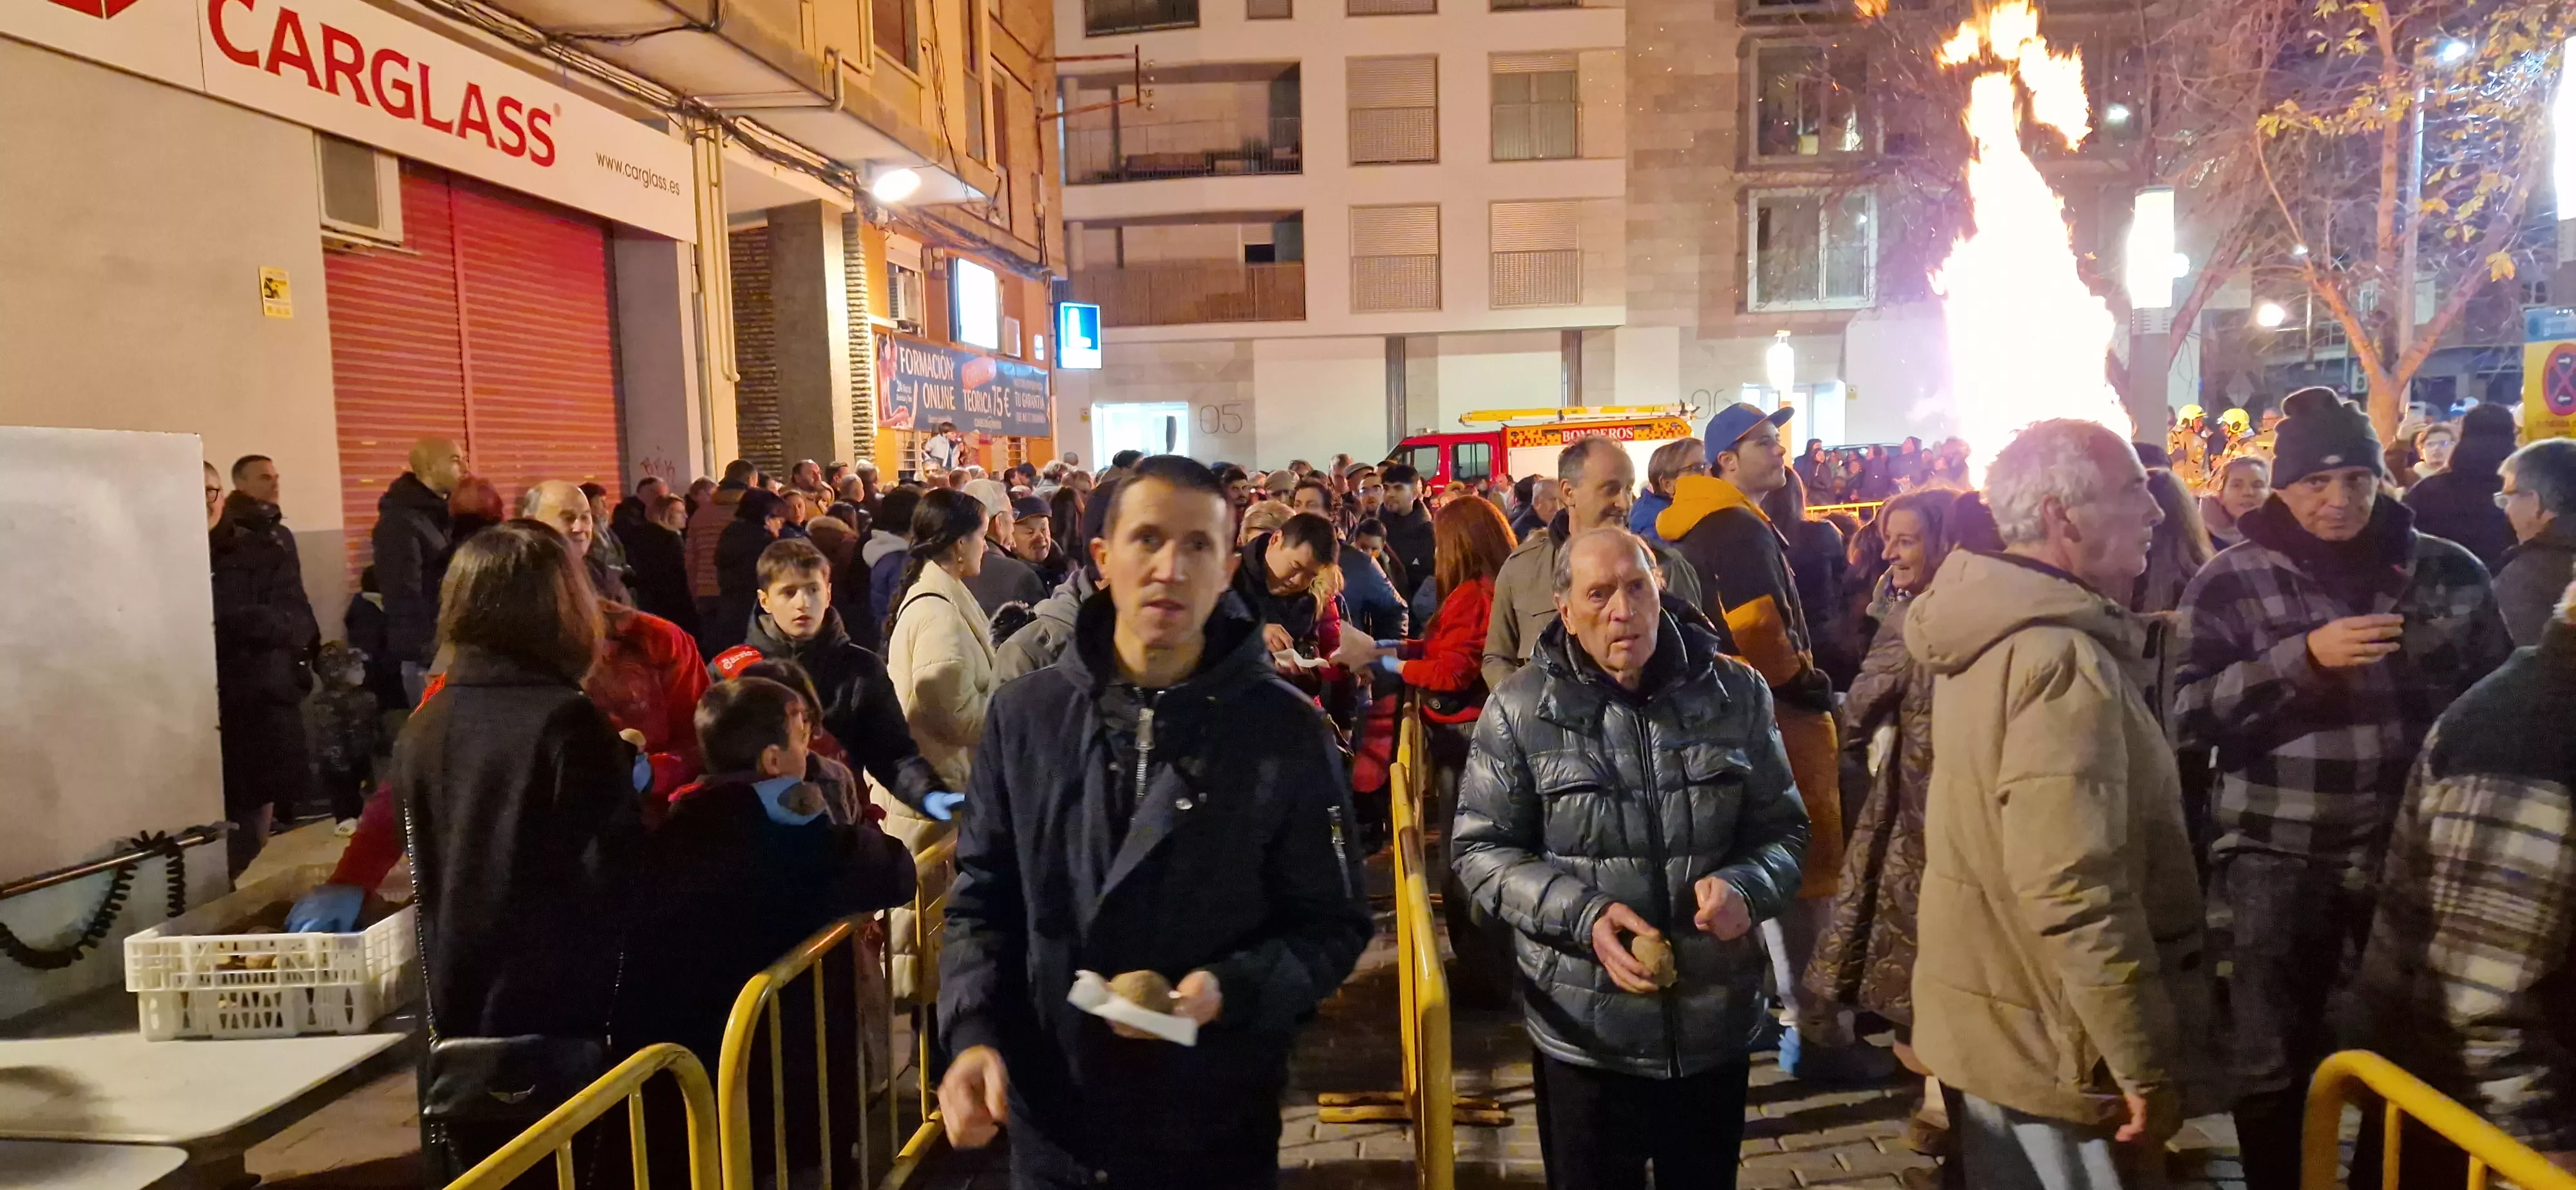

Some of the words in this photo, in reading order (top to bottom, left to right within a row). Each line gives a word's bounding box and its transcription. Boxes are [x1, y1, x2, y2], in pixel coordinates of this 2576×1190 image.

[207, 0, 556, 167] CARGLASS
[596, 152, 680, 196] www.carglass.es
[1067, 307, 1092, 348] L
[899, 347, 954, 381] FORMACIÓN
[922, 382, 956, 410] ONLINE
[1200, 404, 1242, 434] 05
